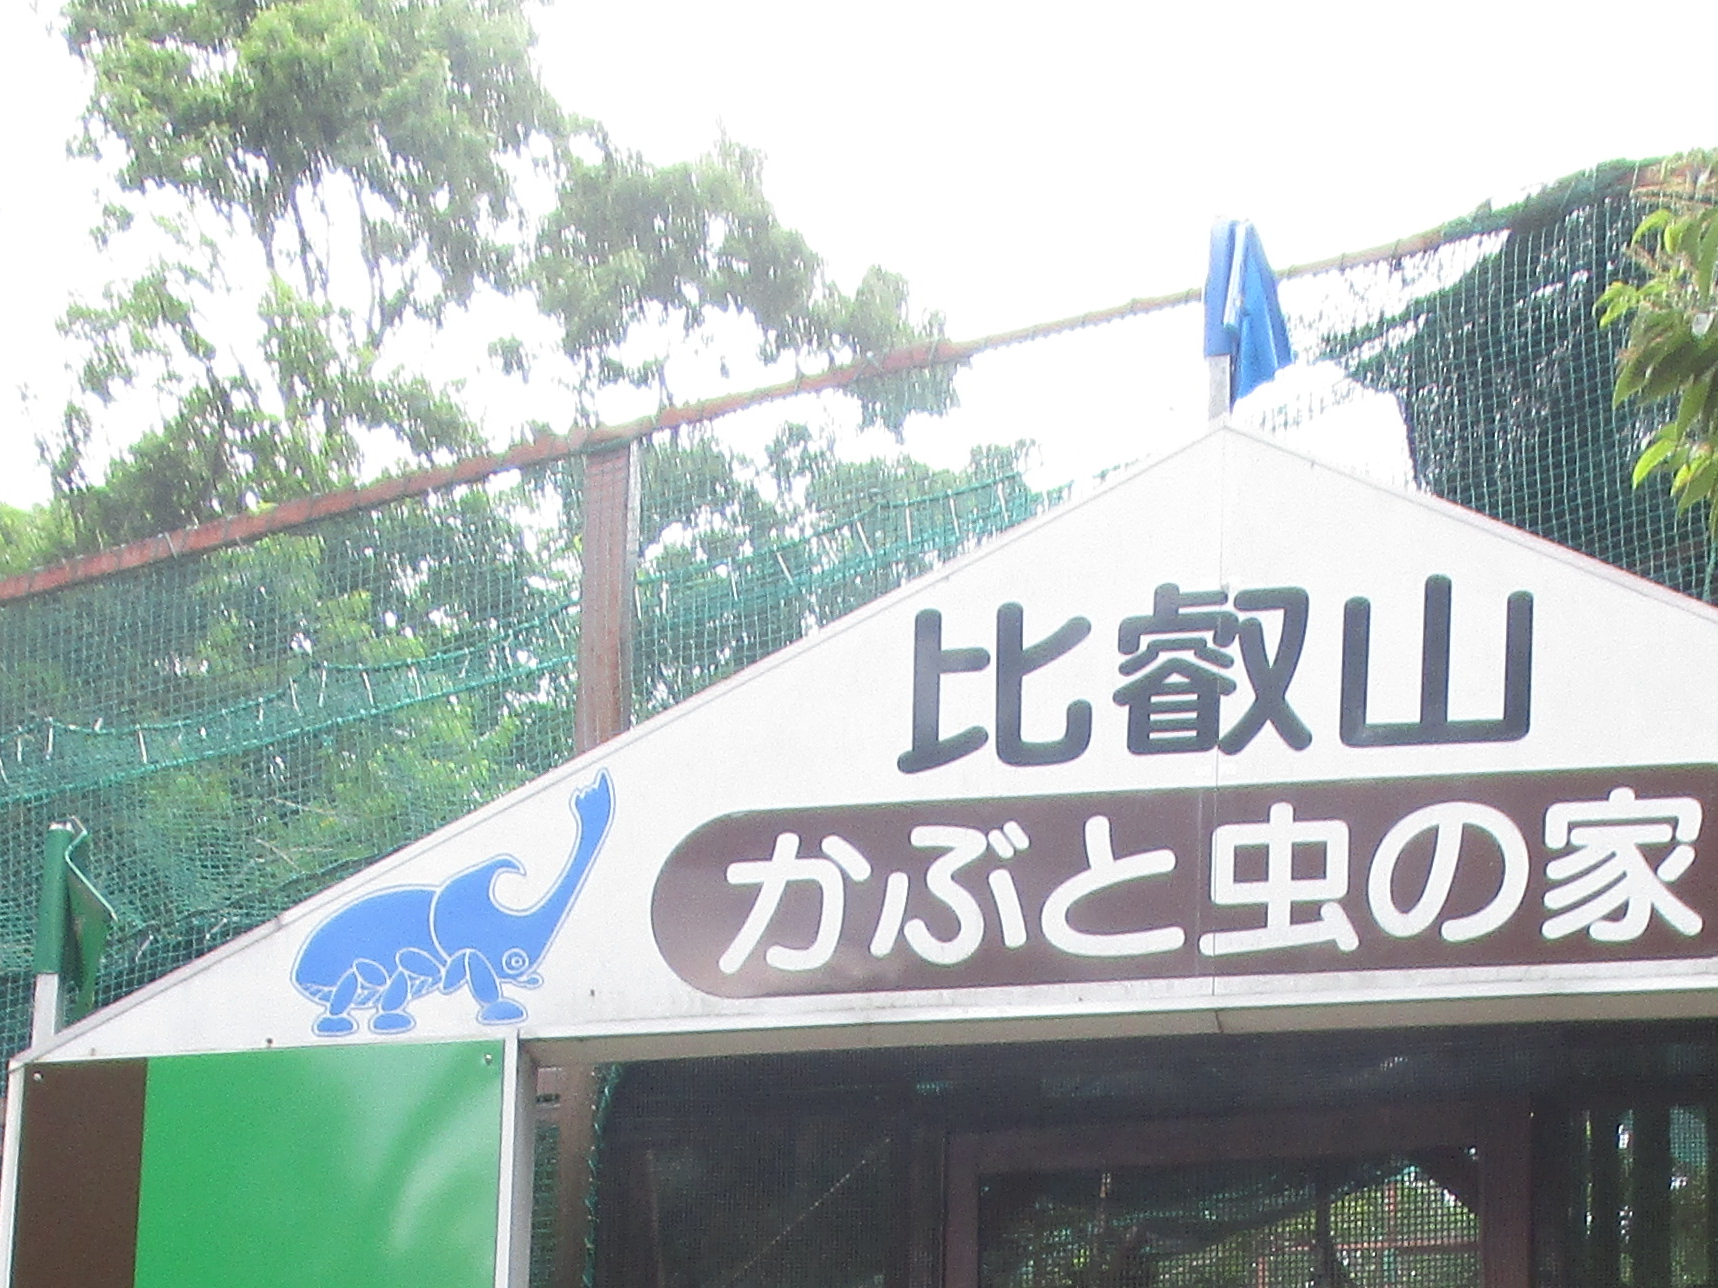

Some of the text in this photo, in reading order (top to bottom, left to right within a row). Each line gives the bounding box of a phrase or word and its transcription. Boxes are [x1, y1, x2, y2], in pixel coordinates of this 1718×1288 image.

[898, 574, 1535, 773] 比叡山
[718, 787, 1704, 974] かぶと虫の家
